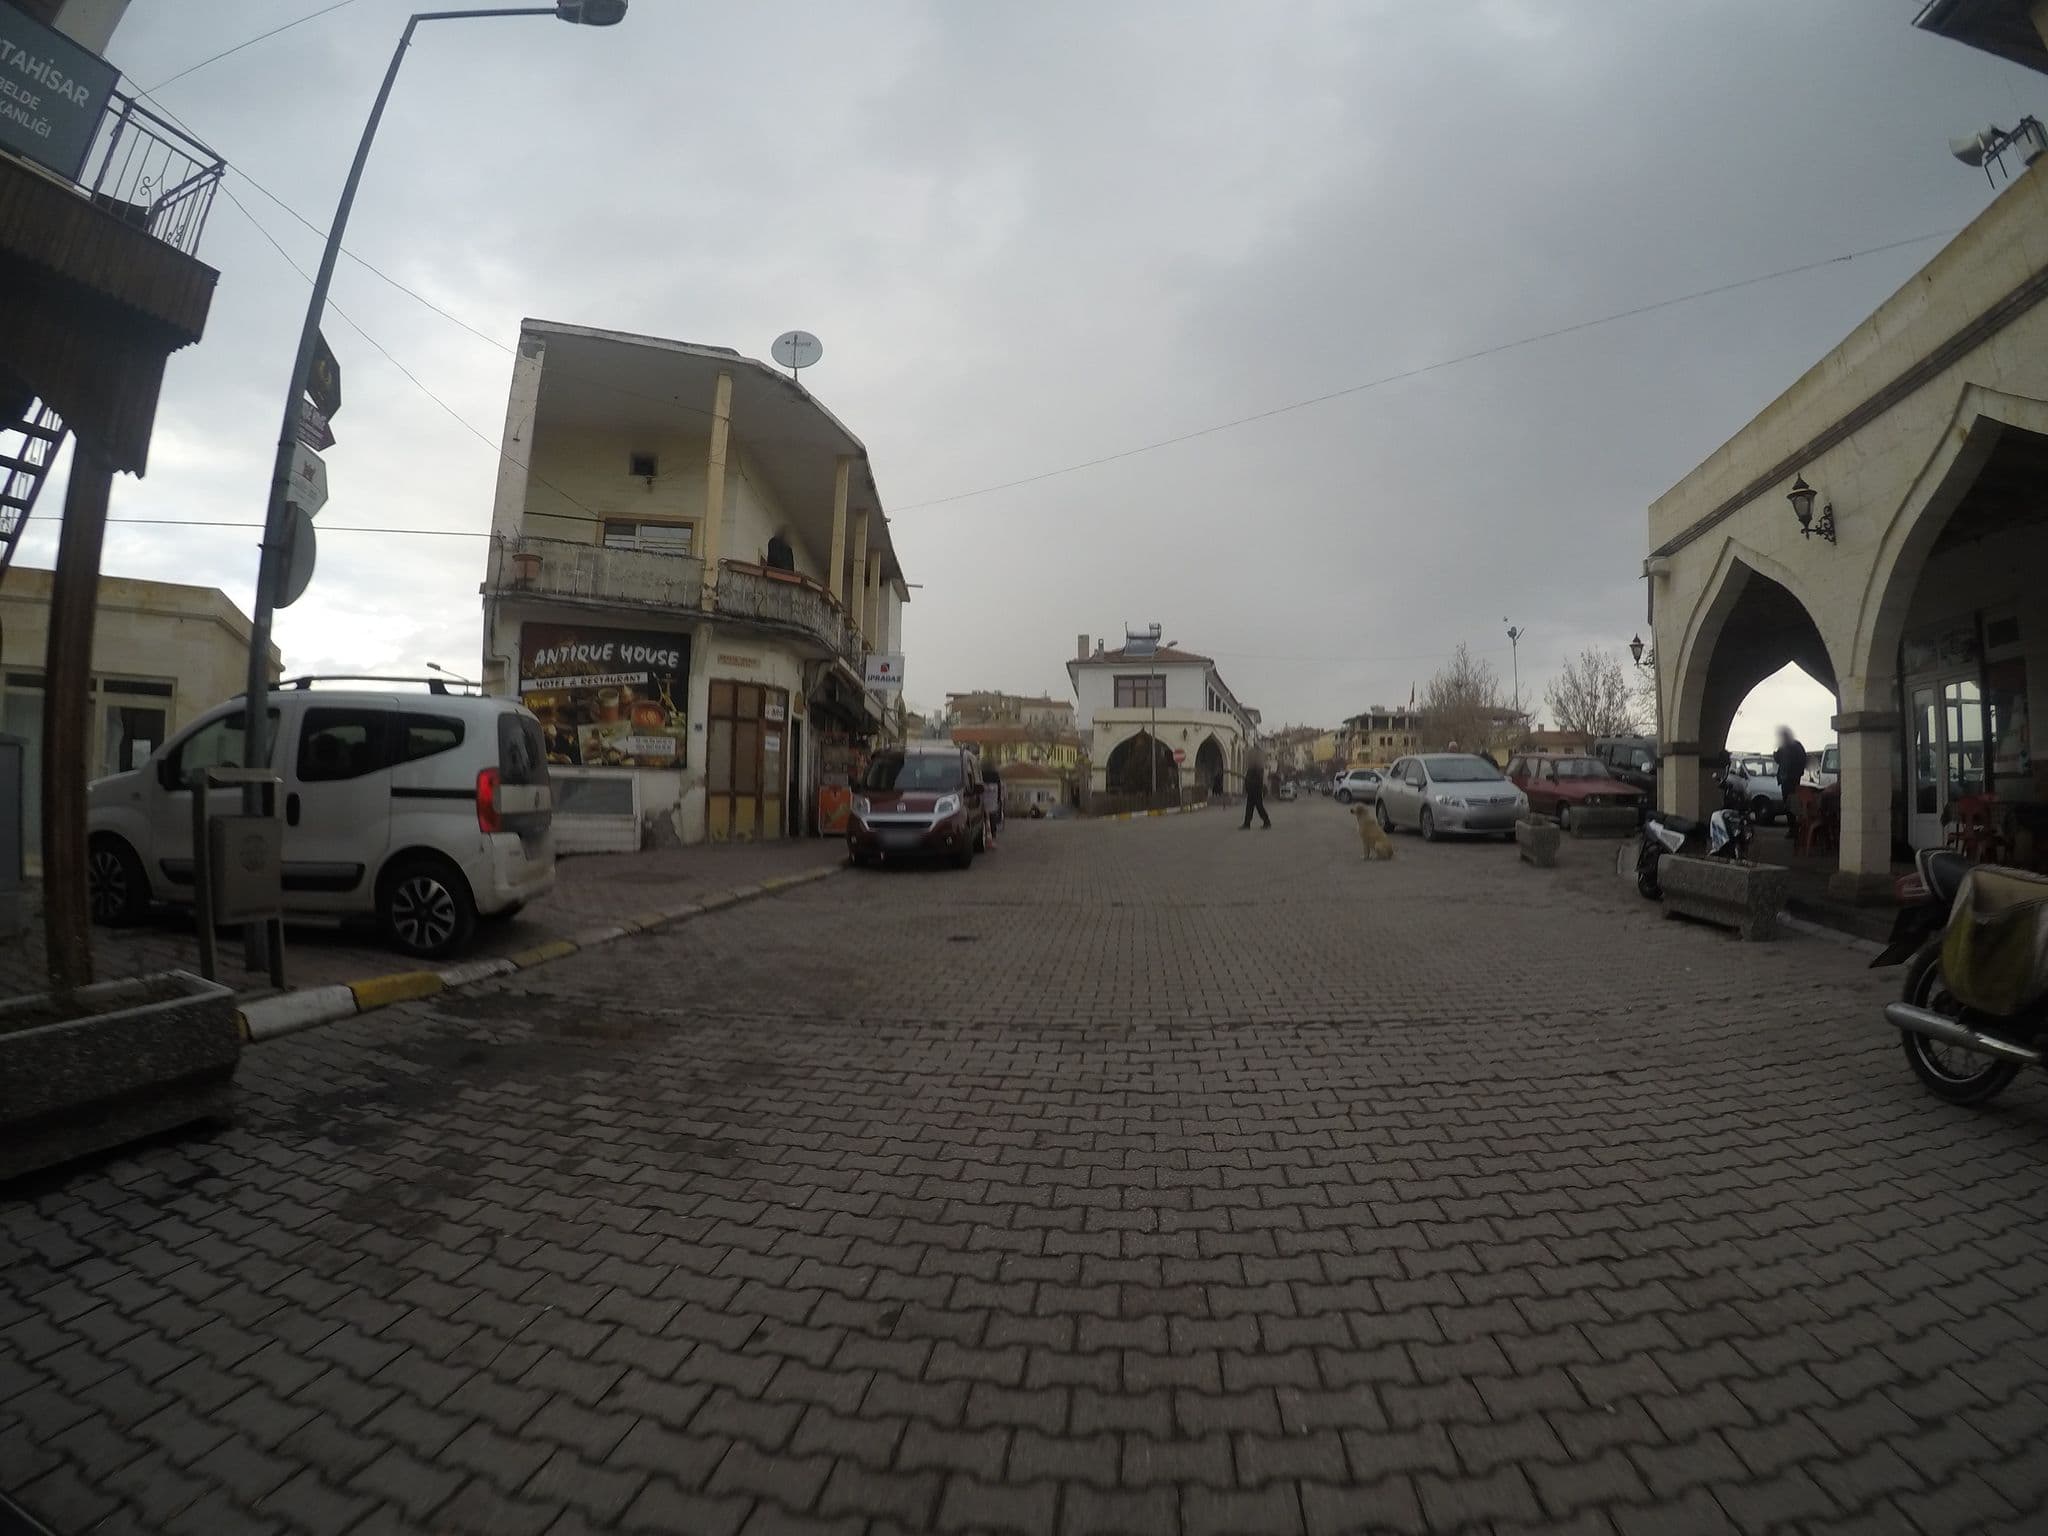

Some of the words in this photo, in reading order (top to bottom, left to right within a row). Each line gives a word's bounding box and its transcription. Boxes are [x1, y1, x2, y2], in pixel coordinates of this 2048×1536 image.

[0, 38, 90, 108] TAHİSAR
[534, 642, 614, 668] ANTIQUE
[620, 643, 680, 669] HOUSE
[535, 679, 565, 690] HOTEL
[580, 674, 641, 686] RESTAURANT
